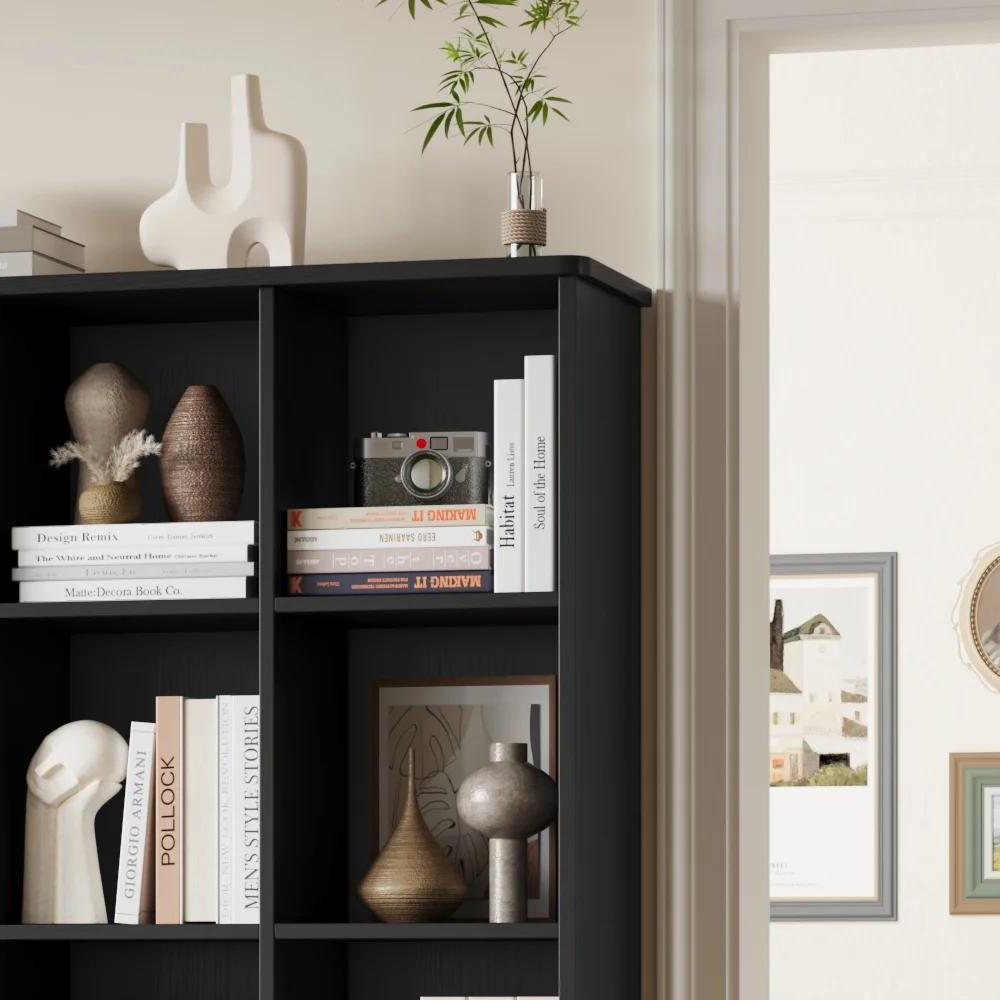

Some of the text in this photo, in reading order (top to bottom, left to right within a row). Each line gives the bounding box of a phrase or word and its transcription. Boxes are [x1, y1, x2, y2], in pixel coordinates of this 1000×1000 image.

[533, 435, 547, 530] Soul of the Home
[411, 509, 426, 522] IT
[427, 508, 477, 521] MAKING
[499, 495, 516, 548] Habitat
[37, 530, 119, 545] Design Remix
[379, 532, 436, 543] EERO SAARINEN
[35, 555, 53, 563] The
[87, 553, 104, 561] and
[413, 575, 482, 588] MAKING IT
[135, 585, 162, 597] Book
[165, 584, 183, 596] Co.
[160, 755, 175, 866] POLLOCK
[244, 705, 259, 910] MEN'S STYLE STORIES
[123, 750, 147, 899] GIORGIO ARMANI
